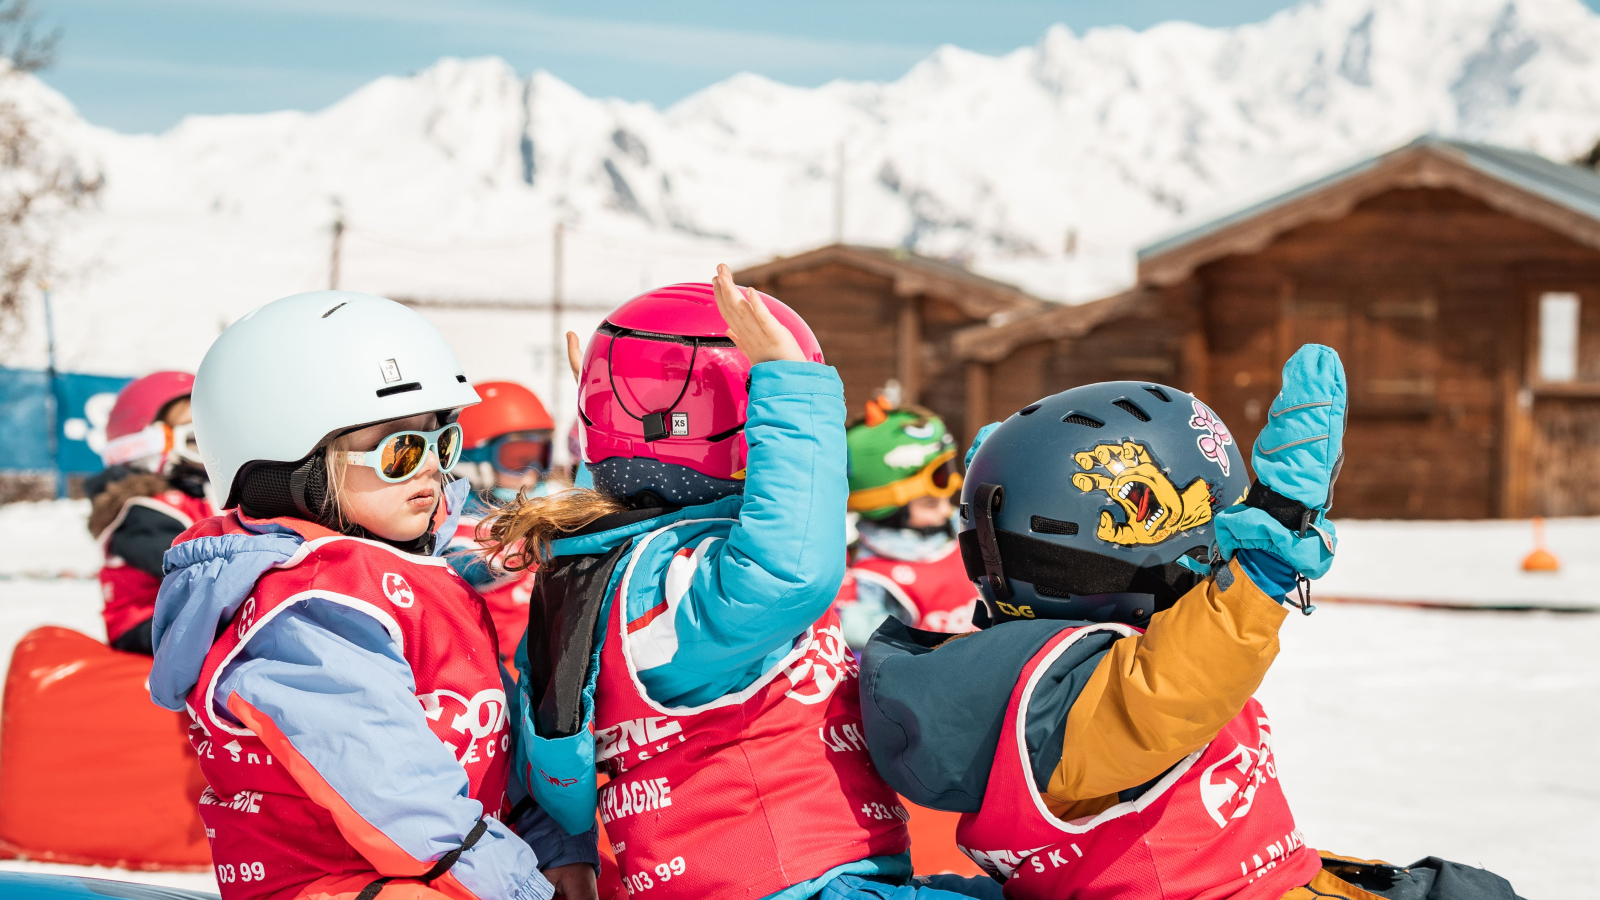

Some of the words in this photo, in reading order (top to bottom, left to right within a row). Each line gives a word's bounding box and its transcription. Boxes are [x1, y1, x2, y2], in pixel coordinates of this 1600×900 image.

[1151, 529, 1170, 543] SANTA
[861, 802, 893, 820] +33
[1031, 843, 1083, 873] SKI
[218, 864, 236, 884] 03
[240, 861, 266, 882] 99
[631, 871, 654, 892] 03
[655, 856, 686, 882] 99
